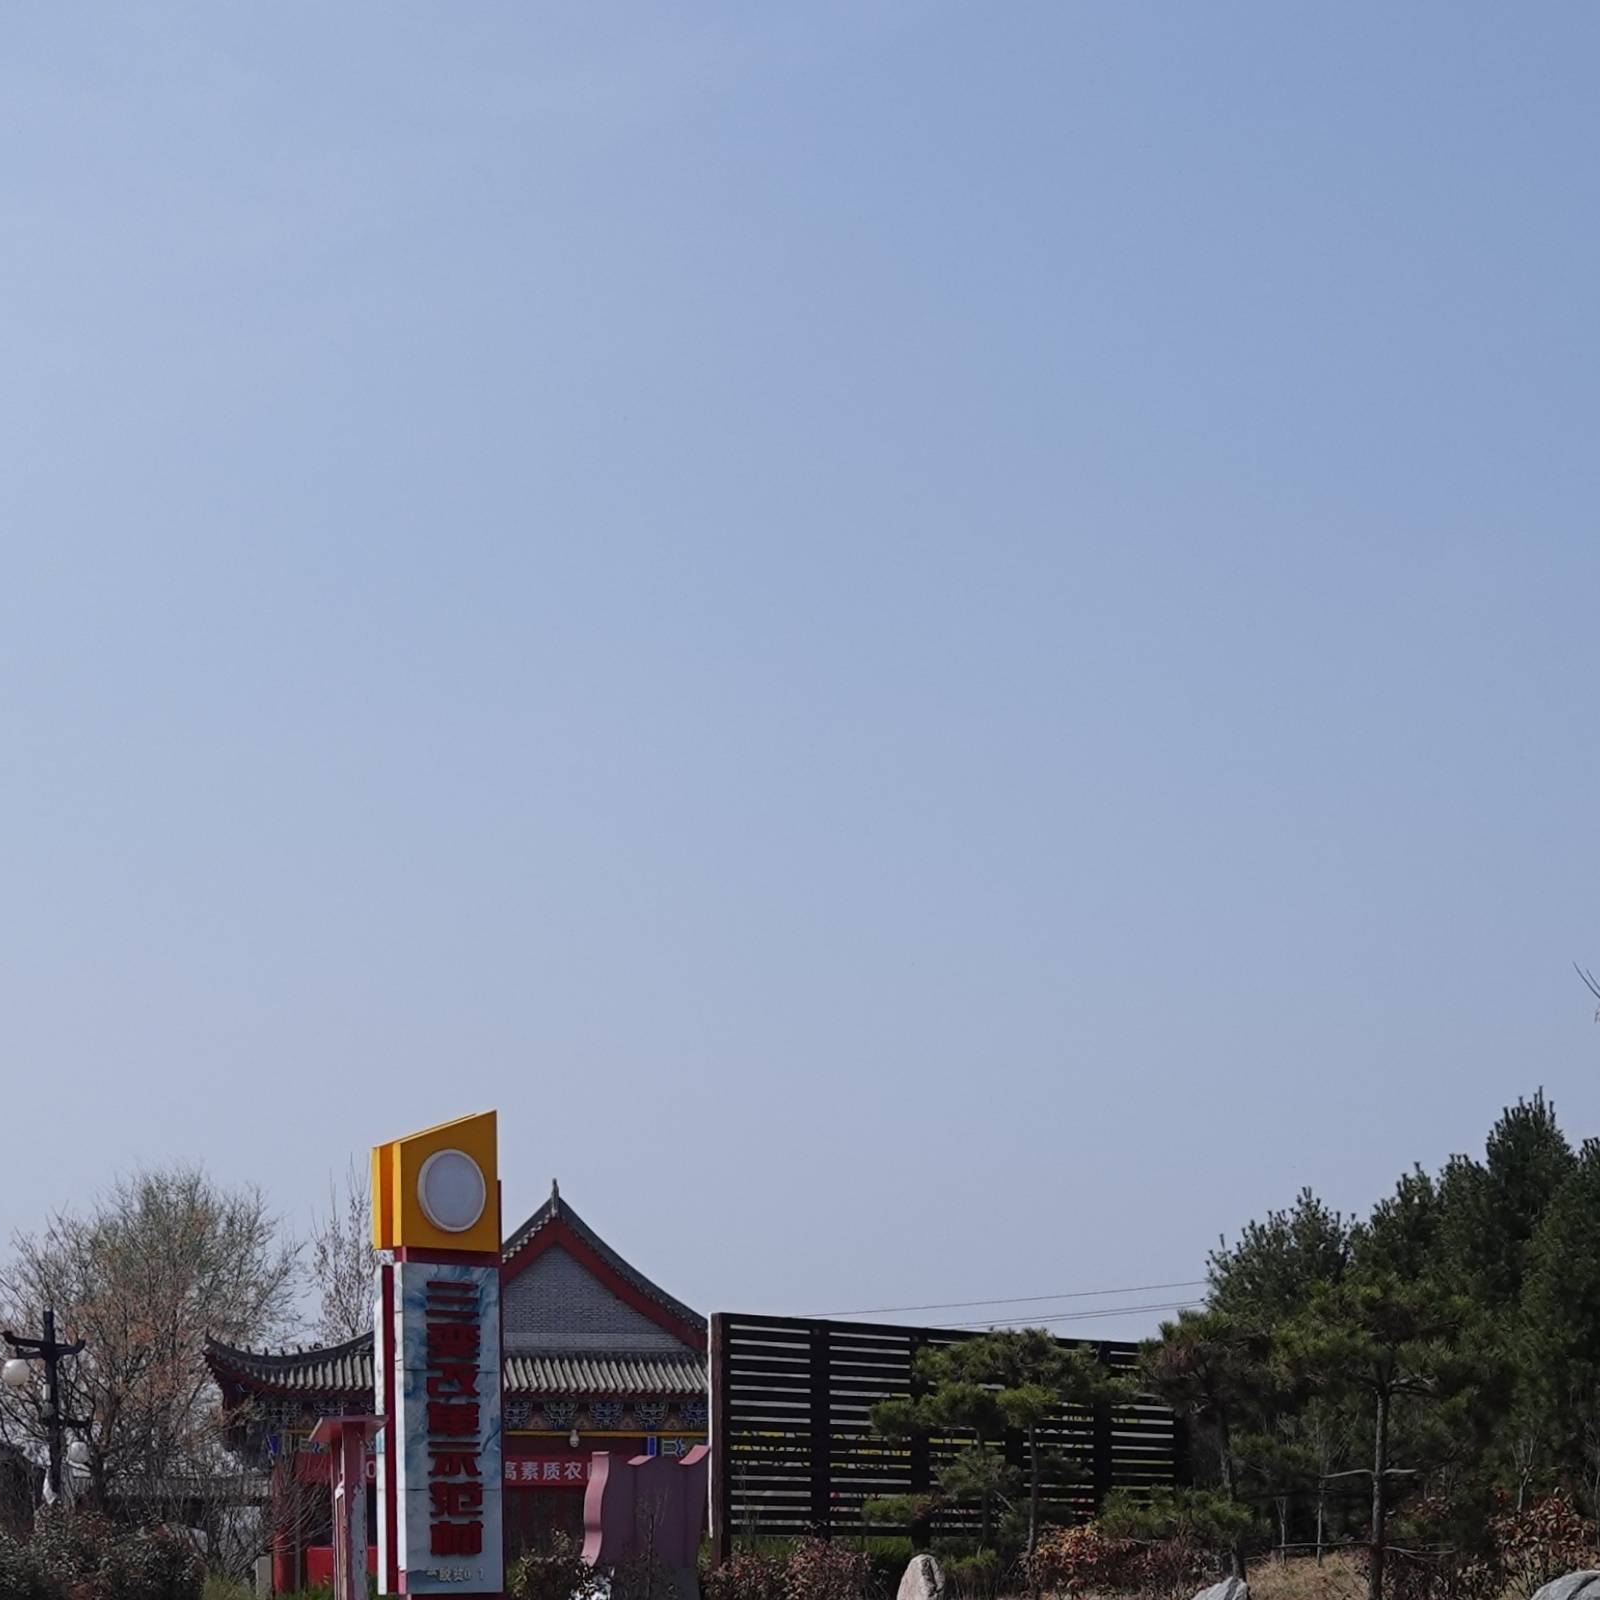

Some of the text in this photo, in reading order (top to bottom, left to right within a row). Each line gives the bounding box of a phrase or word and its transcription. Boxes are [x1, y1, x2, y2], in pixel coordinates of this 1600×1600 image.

[425, 1280, 484, 1557] 三变改革示范村
[504, 1461, 593, 1481] 高素质农
